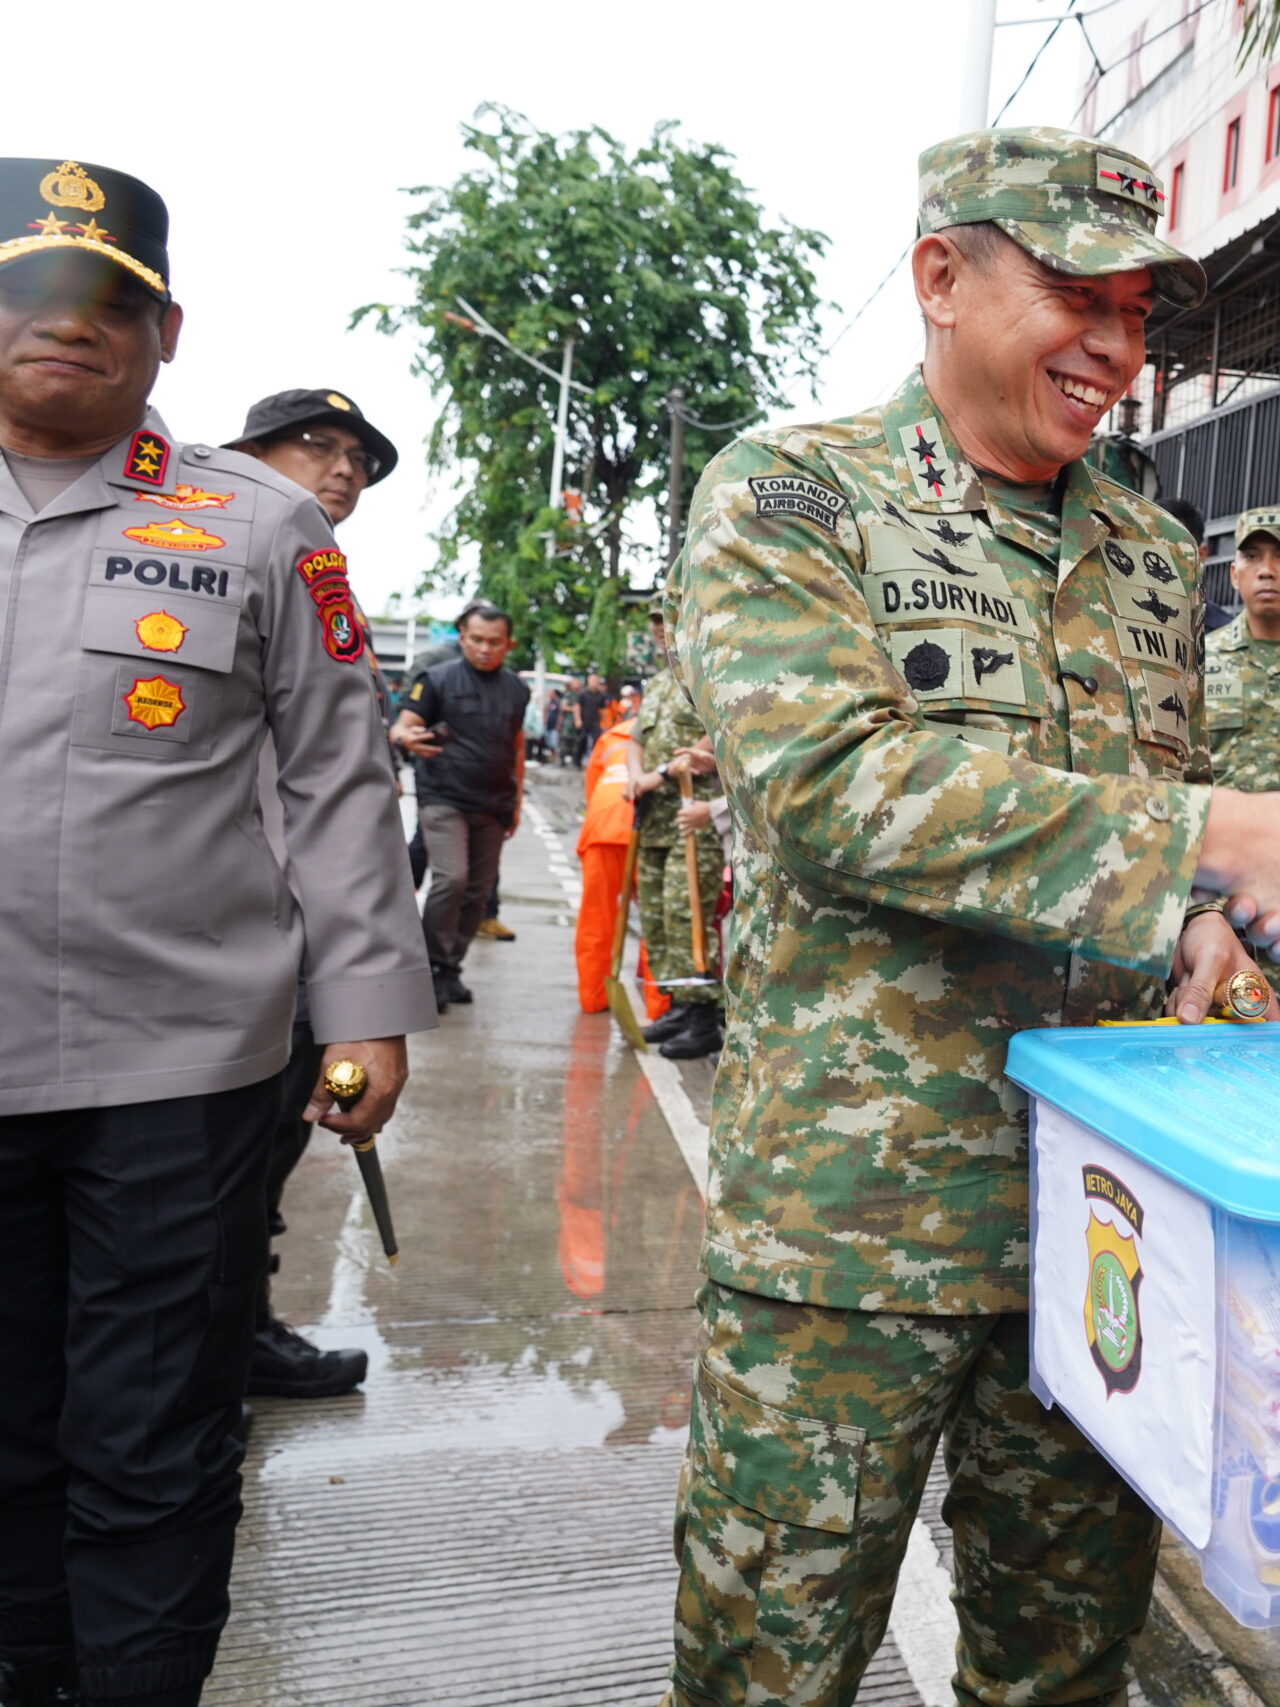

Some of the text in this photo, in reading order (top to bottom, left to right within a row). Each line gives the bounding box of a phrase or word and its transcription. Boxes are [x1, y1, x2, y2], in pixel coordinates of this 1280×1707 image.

[756, 479, 839, 508] KOMANDO
[762, 499, 832, 526] AIRBORNE
[105, 556, 229, 598] POLRI
[882, 578, 1018, 627] D.SURYADI
[1127, 625, 1168, 659] TNI
[1086, 1174, 1138, 1227] METRO JAYA
